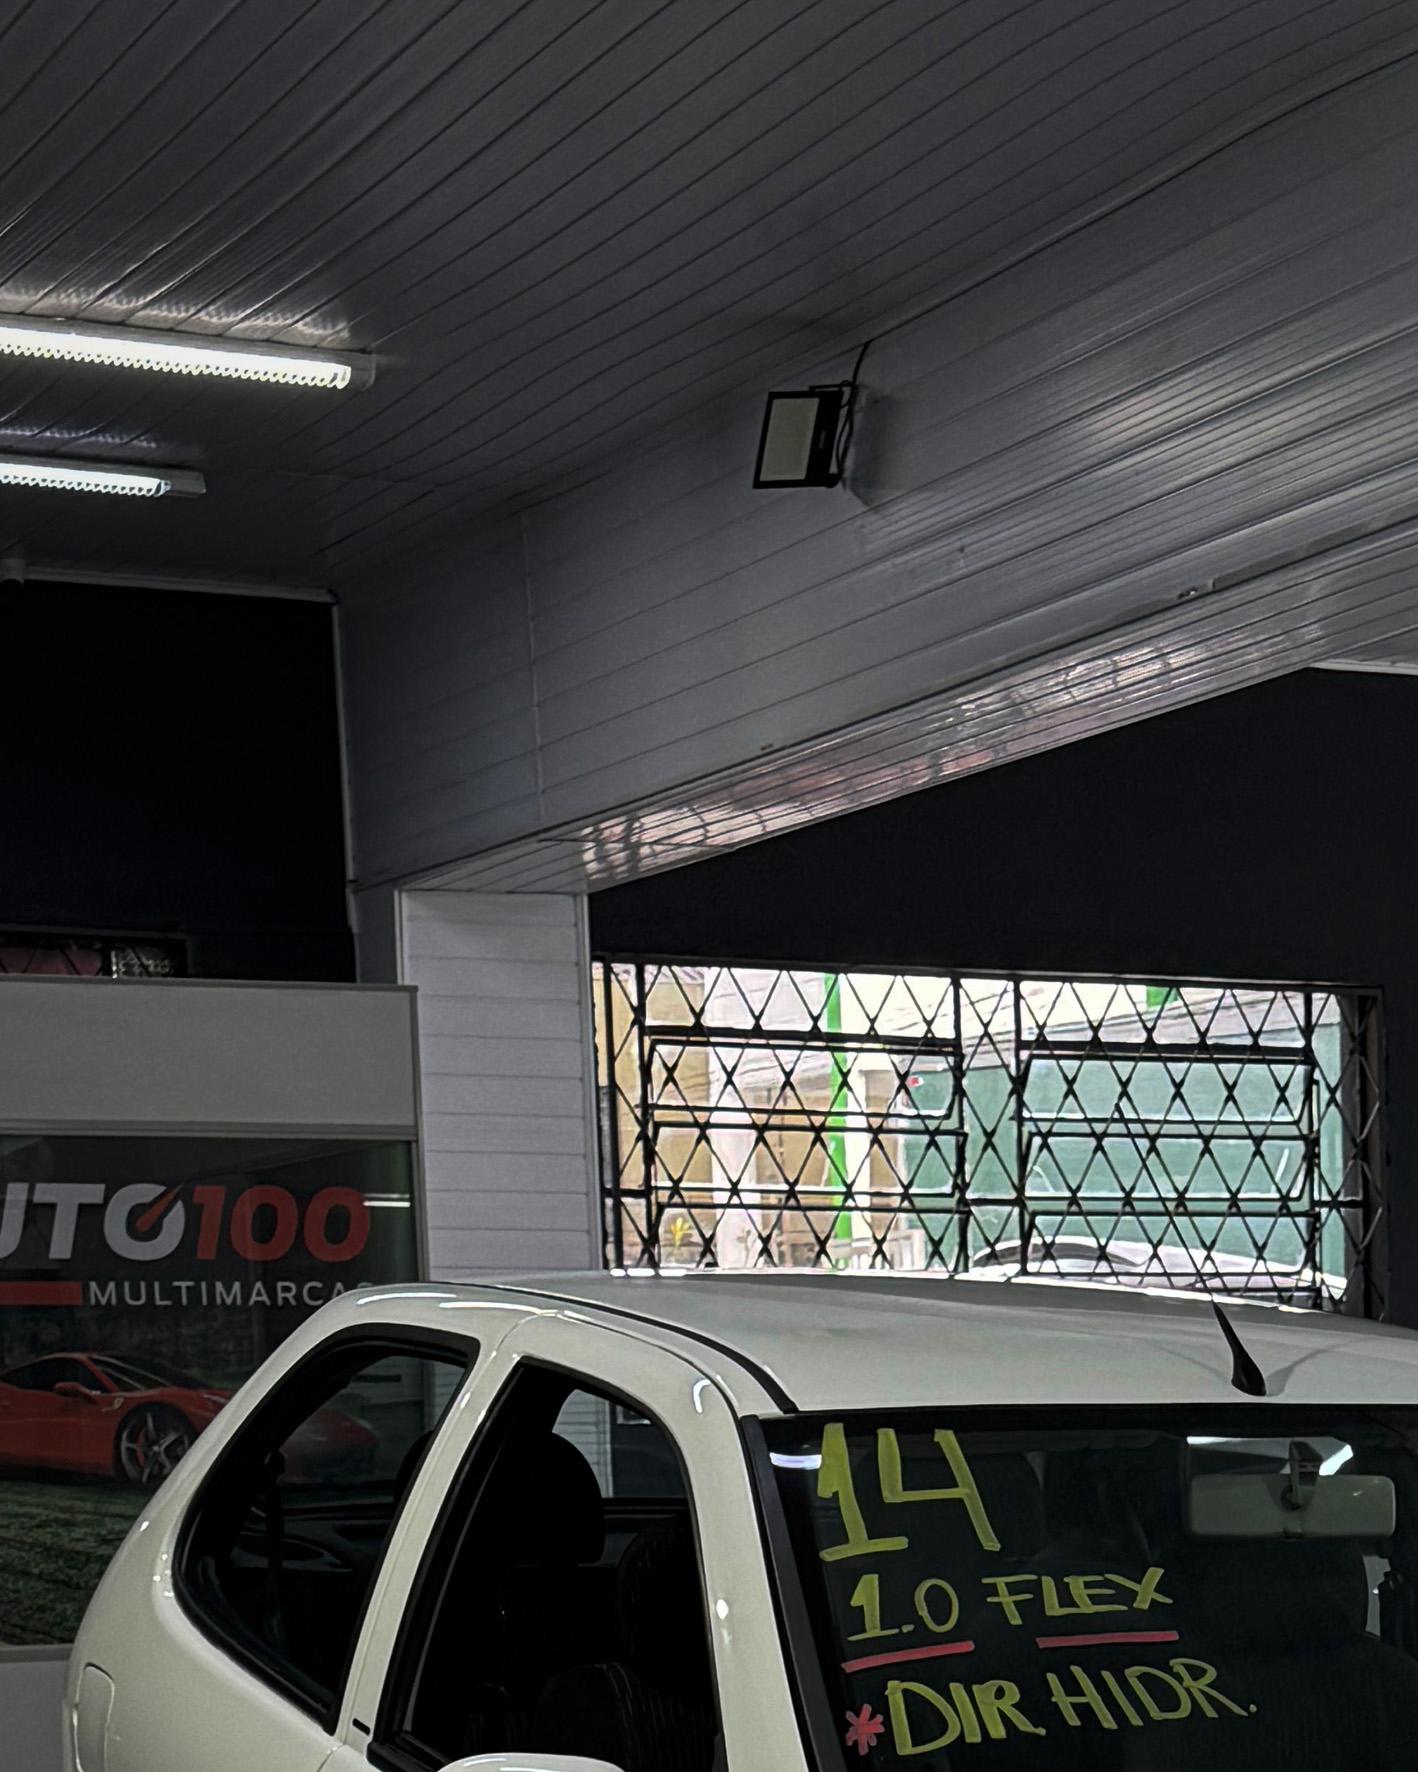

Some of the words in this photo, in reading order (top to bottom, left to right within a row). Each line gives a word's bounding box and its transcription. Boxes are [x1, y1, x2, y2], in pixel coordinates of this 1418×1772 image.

[89, 1280, 374, 1307] MULTIMARCA
[816, 1422, 1001, 1561] 14
[847, 1573, 960, 1640] 1.0
[981, 1566, 1173, 1626] FLEX
[1046, 1657, 1258, 1730] HIDR.
